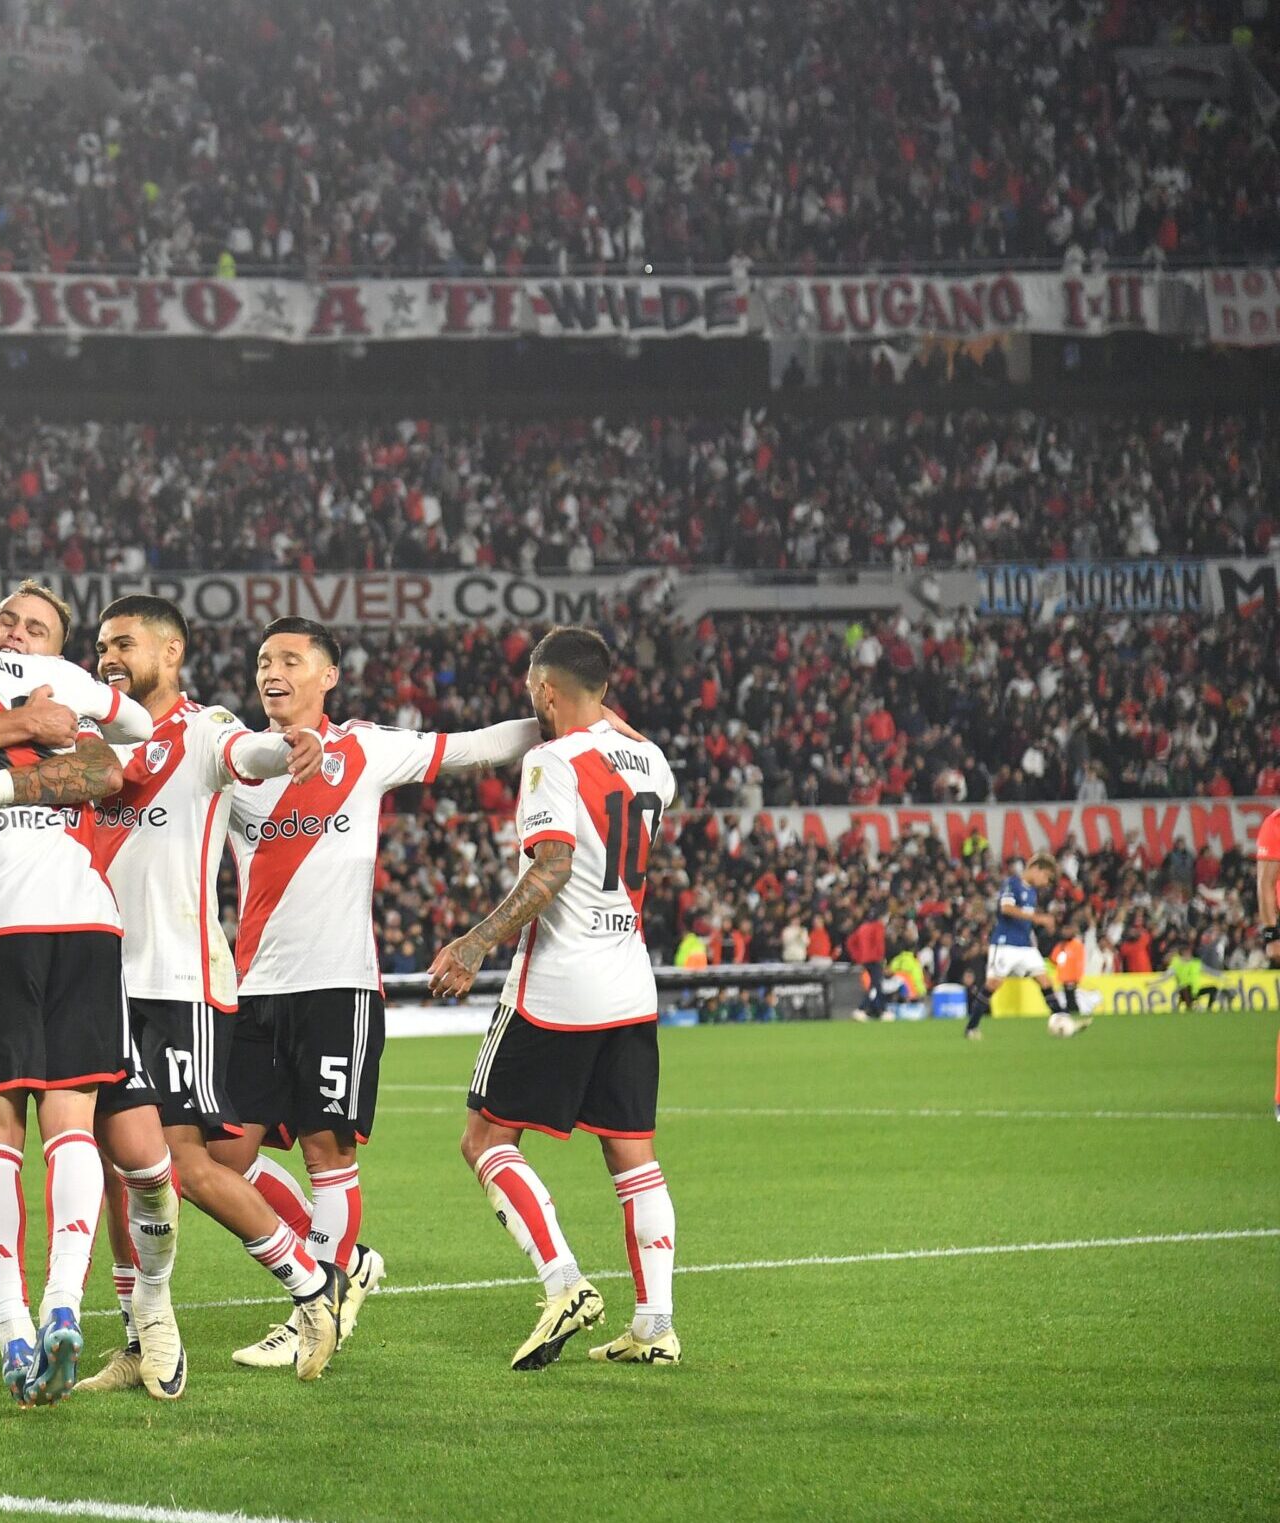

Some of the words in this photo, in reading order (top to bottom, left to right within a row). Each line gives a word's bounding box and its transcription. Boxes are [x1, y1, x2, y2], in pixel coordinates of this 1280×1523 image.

[308, 285, 371, 335] A
[427, 282, 517, 333] TI
[539, 282, 738, 331] WILDE
[810, 277, 1026, 332] LUGANO
[1065, 564, 1202, 611] NORMAN
[94, 798, 168, 828] odere
[245, 810, 352, 843] codere
[602, 790, 662, 892] 10
[166, 1046, 194, 1093] 17
[320, 1055, 349, 1100] 5
